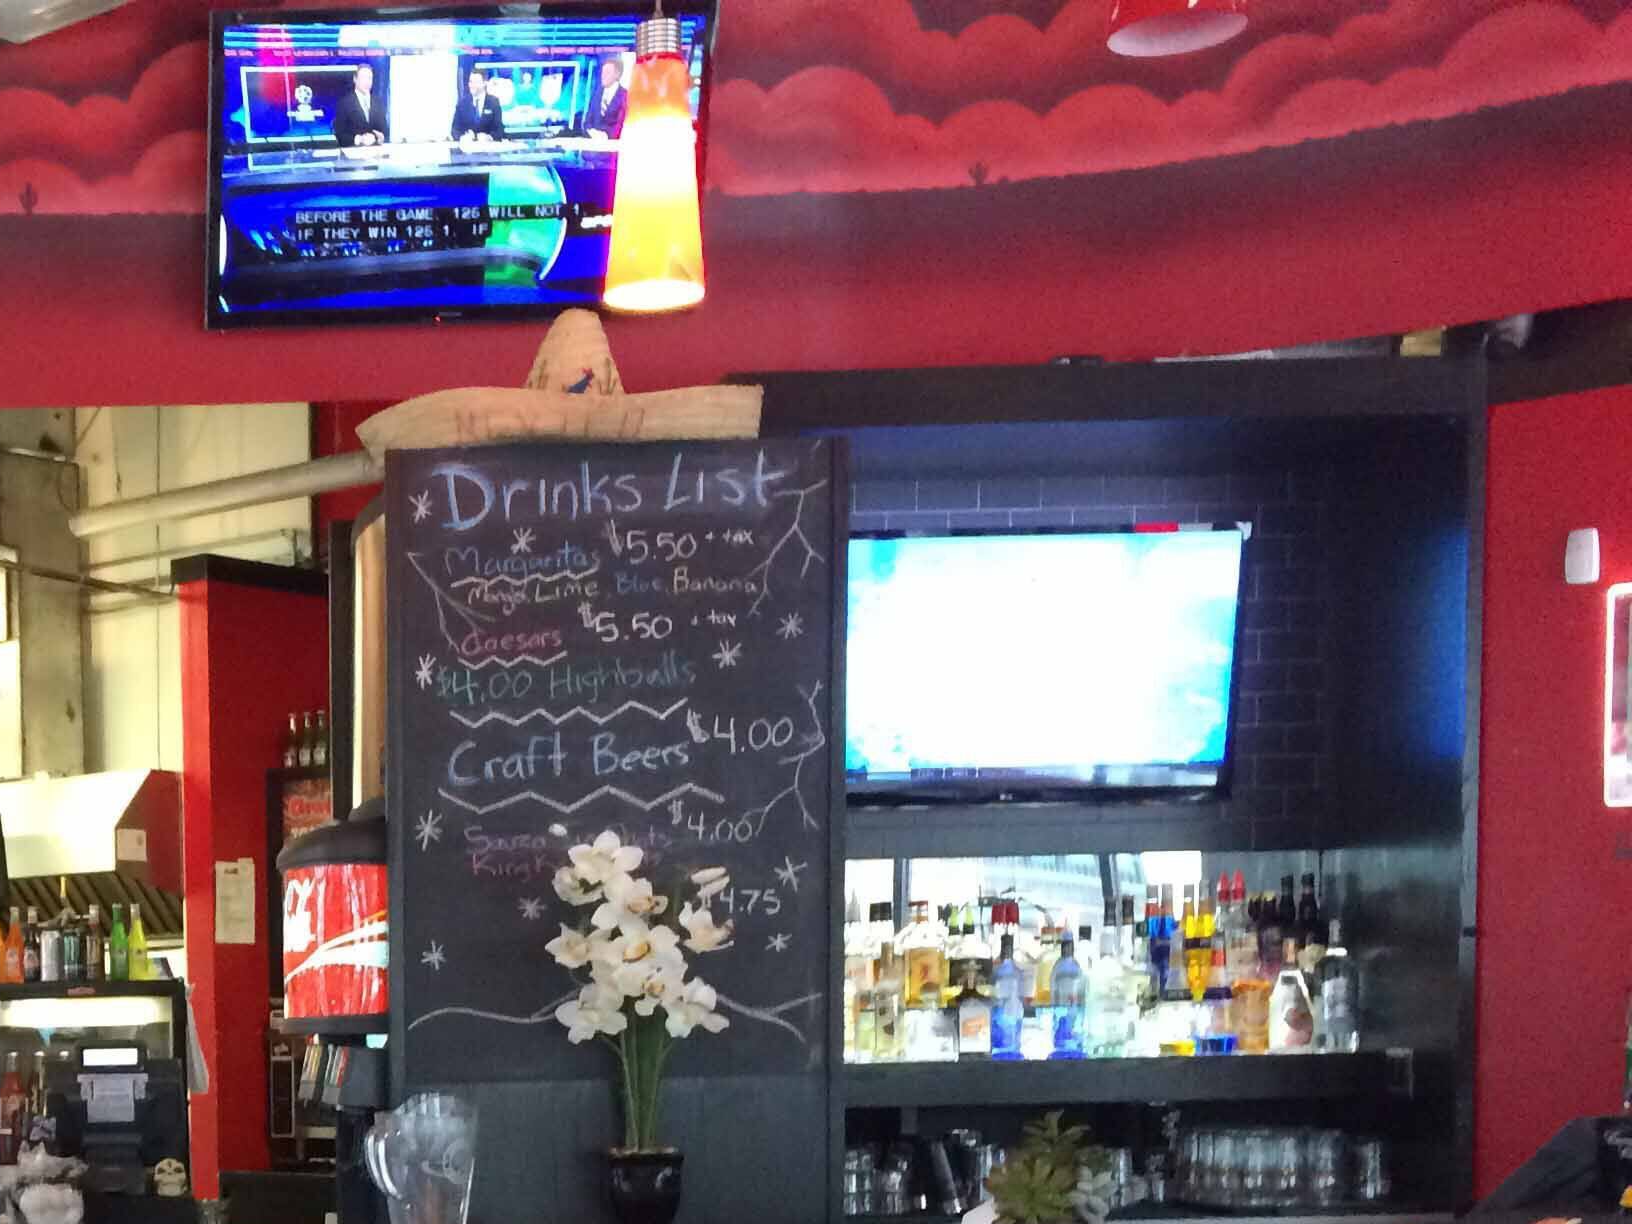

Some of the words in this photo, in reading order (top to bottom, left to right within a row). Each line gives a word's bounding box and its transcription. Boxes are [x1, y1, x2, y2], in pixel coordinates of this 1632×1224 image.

[295, 210, 351, 224] BEFORE
[359, 209, 389, 223] THE
[488, 206, 526, 218] WILL
[535, 205, 561, 217] NOT
[296, 228, 314, 240] IF
[323, 227, 360, 240] THEY
[368, 227, 397, 239] WIN
[472, 223, 489, 236] IF
[431, 460, 642, 532] Drinks
[448, 731, 569, 787] Craft
[592, 731, 691, 777] Beers
